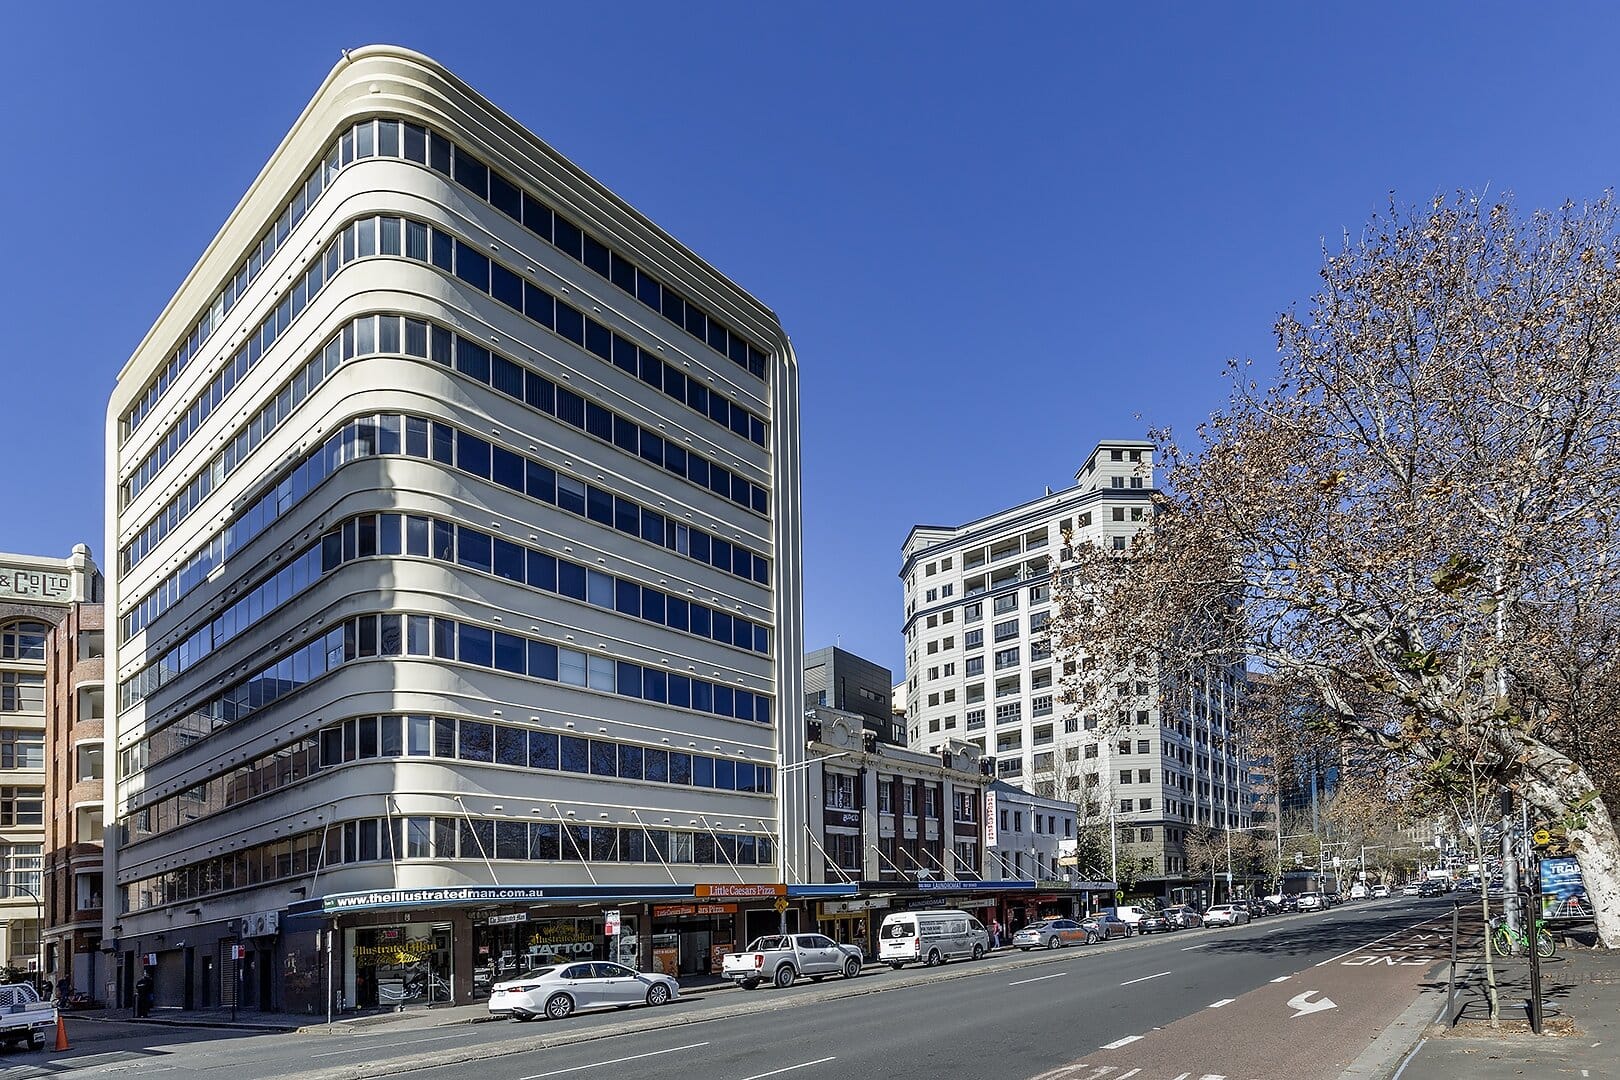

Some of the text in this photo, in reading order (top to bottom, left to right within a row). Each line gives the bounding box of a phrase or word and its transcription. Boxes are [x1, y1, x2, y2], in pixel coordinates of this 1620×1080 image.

[709, 886, 775, 896] Little Caesars Pizza
[337, 889, 544, 907] www.theillustratedman.com.au
[709, 905, 724, 913] Pizza
[530, 941, 594, 955] TATTOO
